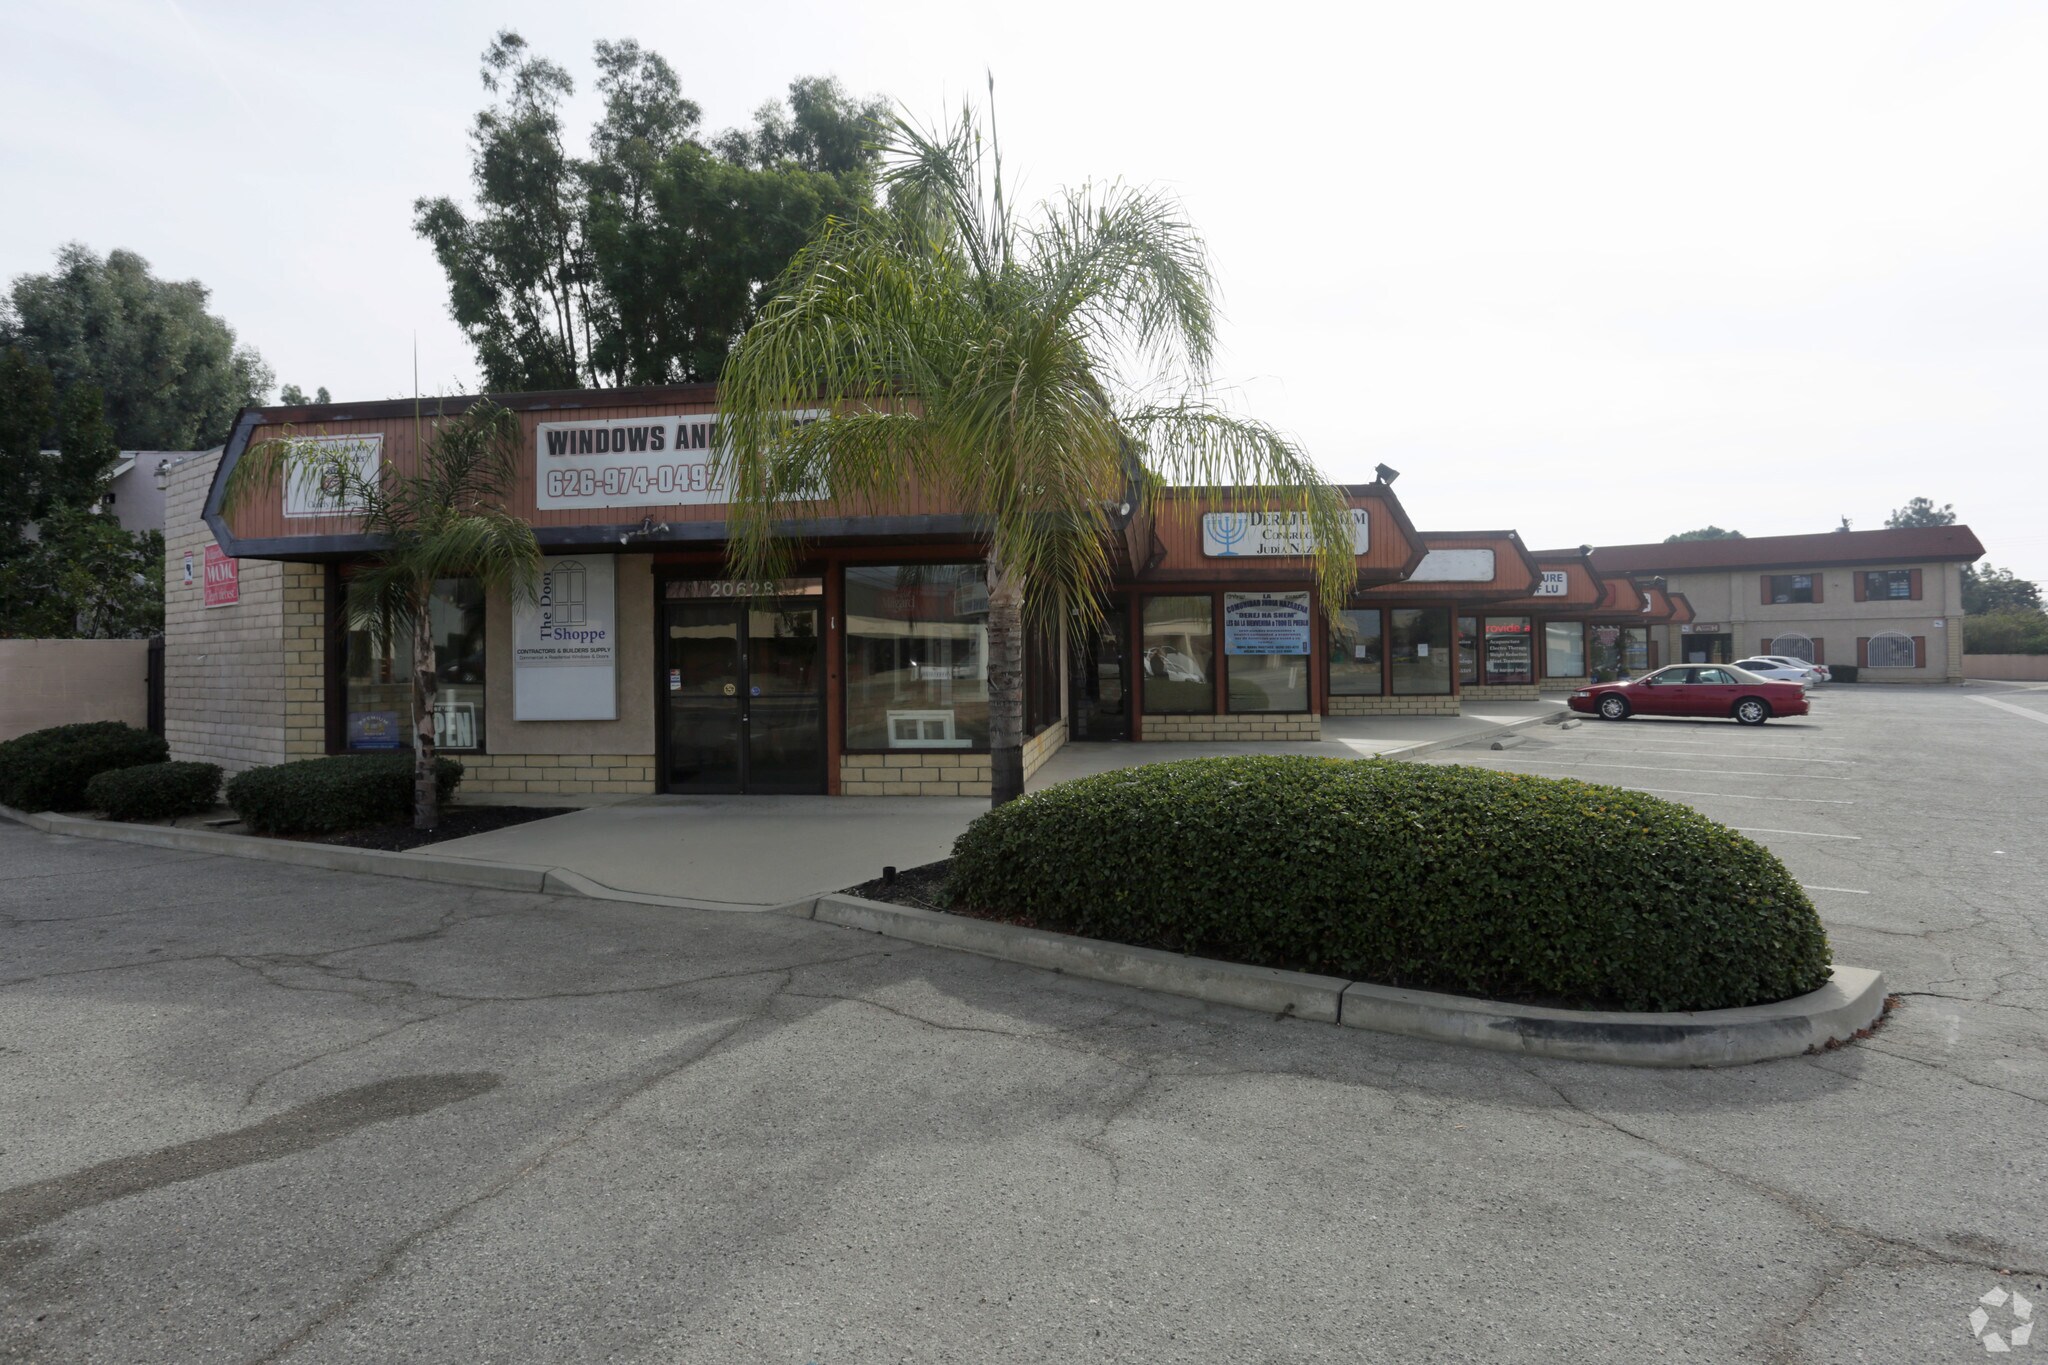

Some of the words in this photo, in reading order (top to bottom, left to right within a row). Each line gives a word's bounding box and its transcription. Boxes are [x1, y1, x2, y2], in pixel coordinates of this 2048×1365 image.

[546, 425, 665, 456] WINDOWS
[547, 463, 725, 497] 626-974-0492
[540, 572, 552, 607] Door
[1545, 585, 1559, 593] LU
[1226, 600, 1261, 613] COMUNIDAD
[540, 612, 552, 641] The
[554, 628, 605, 643] Shoppe
[1486, 624, 1520, 632] rovide
[434, 712, 471, 747] PEN
